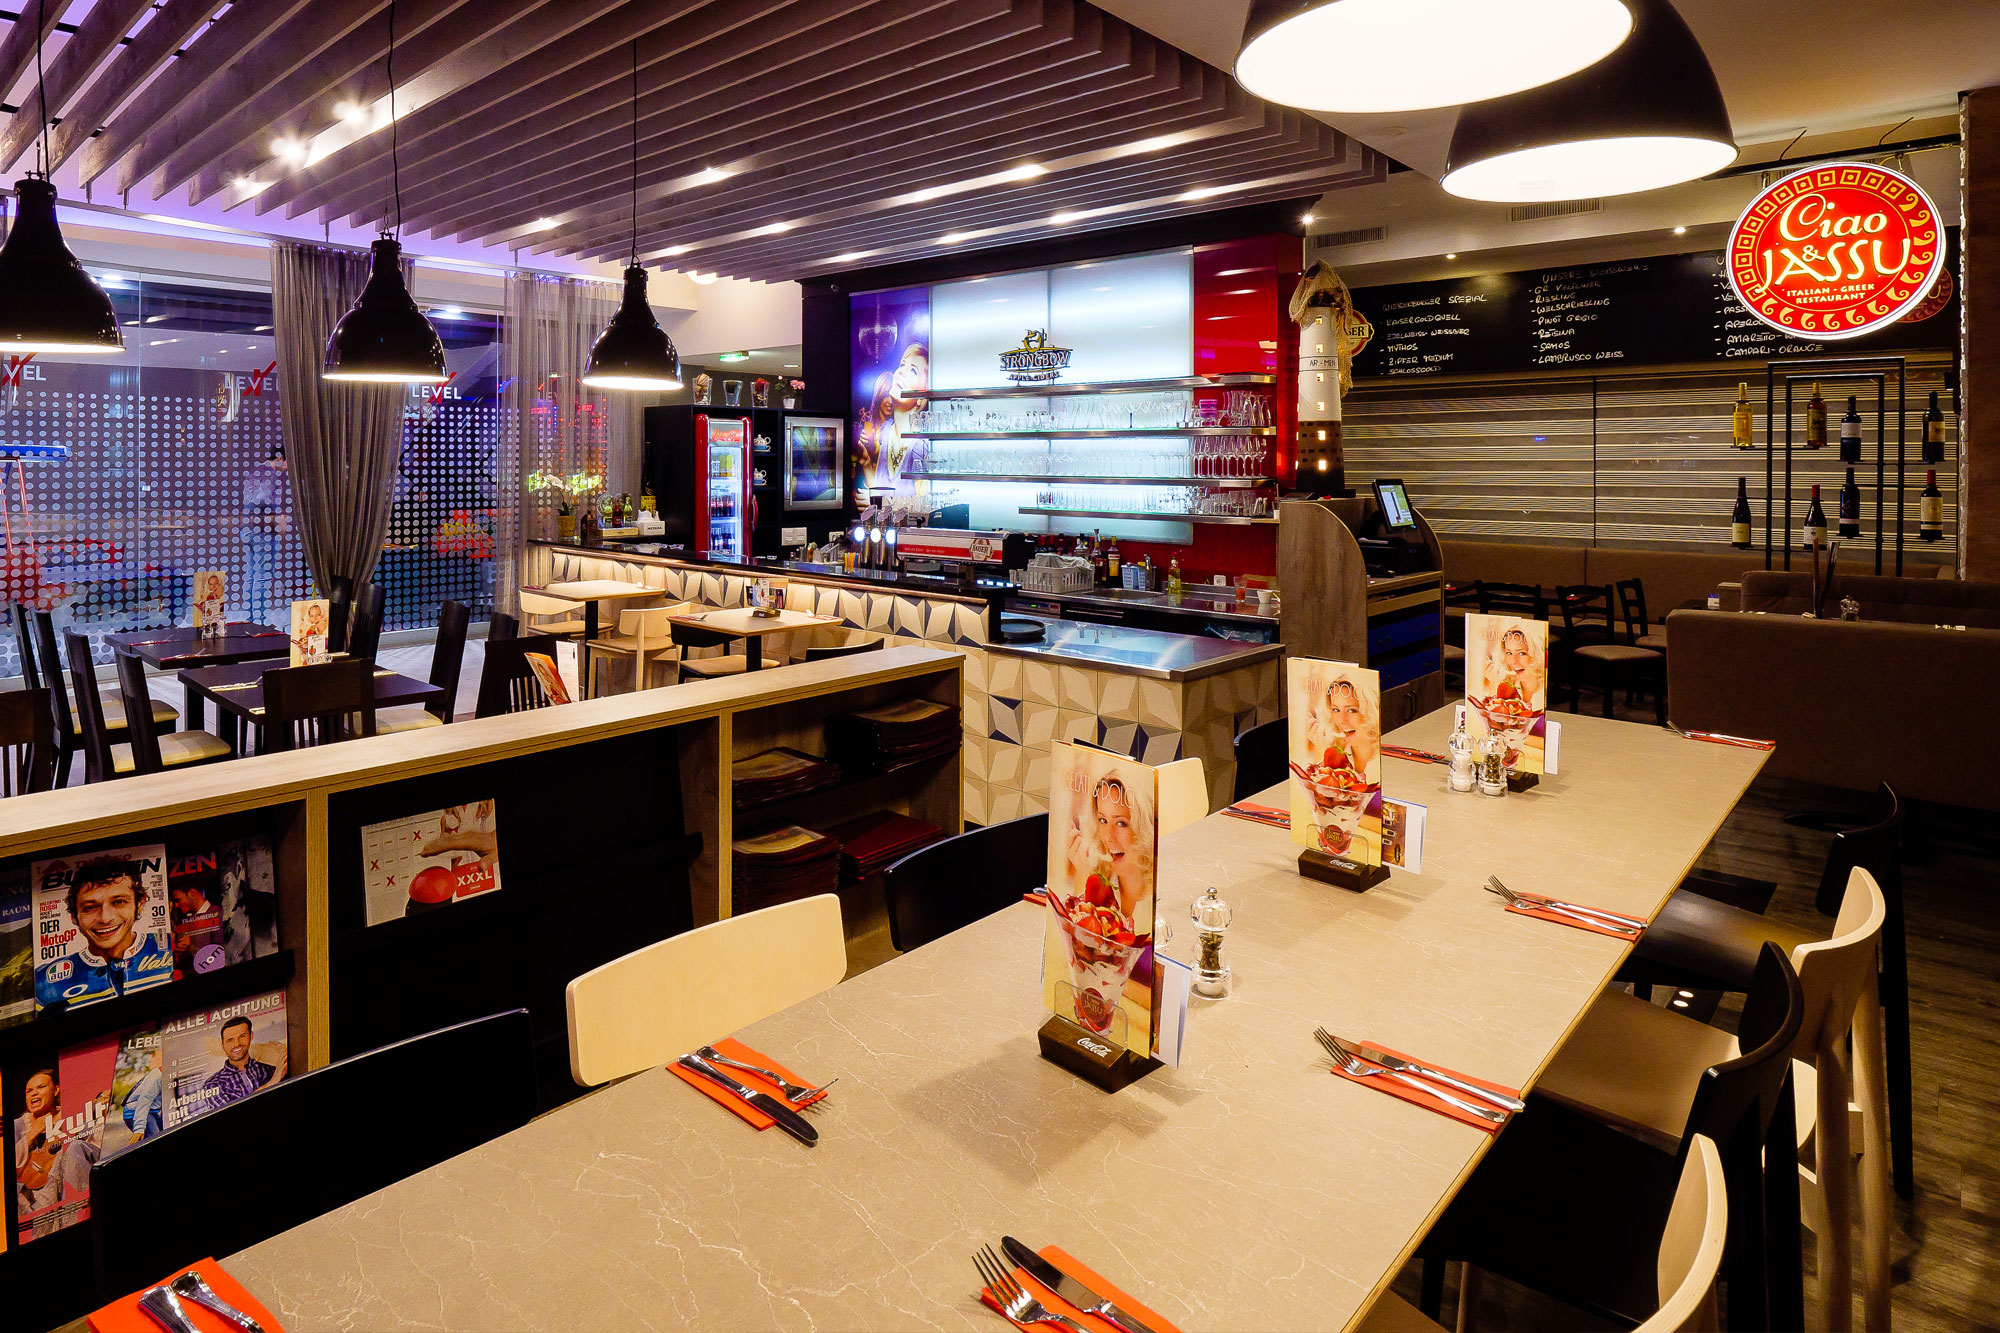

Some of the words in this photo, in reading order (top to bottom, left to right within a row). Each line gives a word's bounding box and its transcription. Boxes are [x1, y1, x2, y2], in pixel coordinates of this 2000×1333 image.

[1779, 193, 1888, 242] Ciao
[1754, 238, 1911, 294] JASSU
[1787, 287, 1830, 297] ITALIAN
[1840, 283, 1875, 292] GREEK
[1796, 292, 1866, 304] RESTAURANT
[1538, 315, 1561, 326] PINOT
[1539, 341, 1571, 352] SAMOS
[1000, 351, 1070, 369] STRONGBOW
[1538, 353, 1592, 364] LAMBRUSCO
[1595, 350, 1624, 360] WEISS
[3, 363, 47, 381] VEL
[412, 385, 462, 400] LEVEL
[457, 870, 493, 887] XXXL
[2, 904, 31, 917] RAUM
[151, 905, 166, 917] 30
[40, 919, 60, 934] DER
[40, 928, 77, 947] MotoGP
[41, 943, 68, 960] GOTT
[168, 1086, 220, 1110] Arbeiten
[168, 1106, 189, 1122] mit
